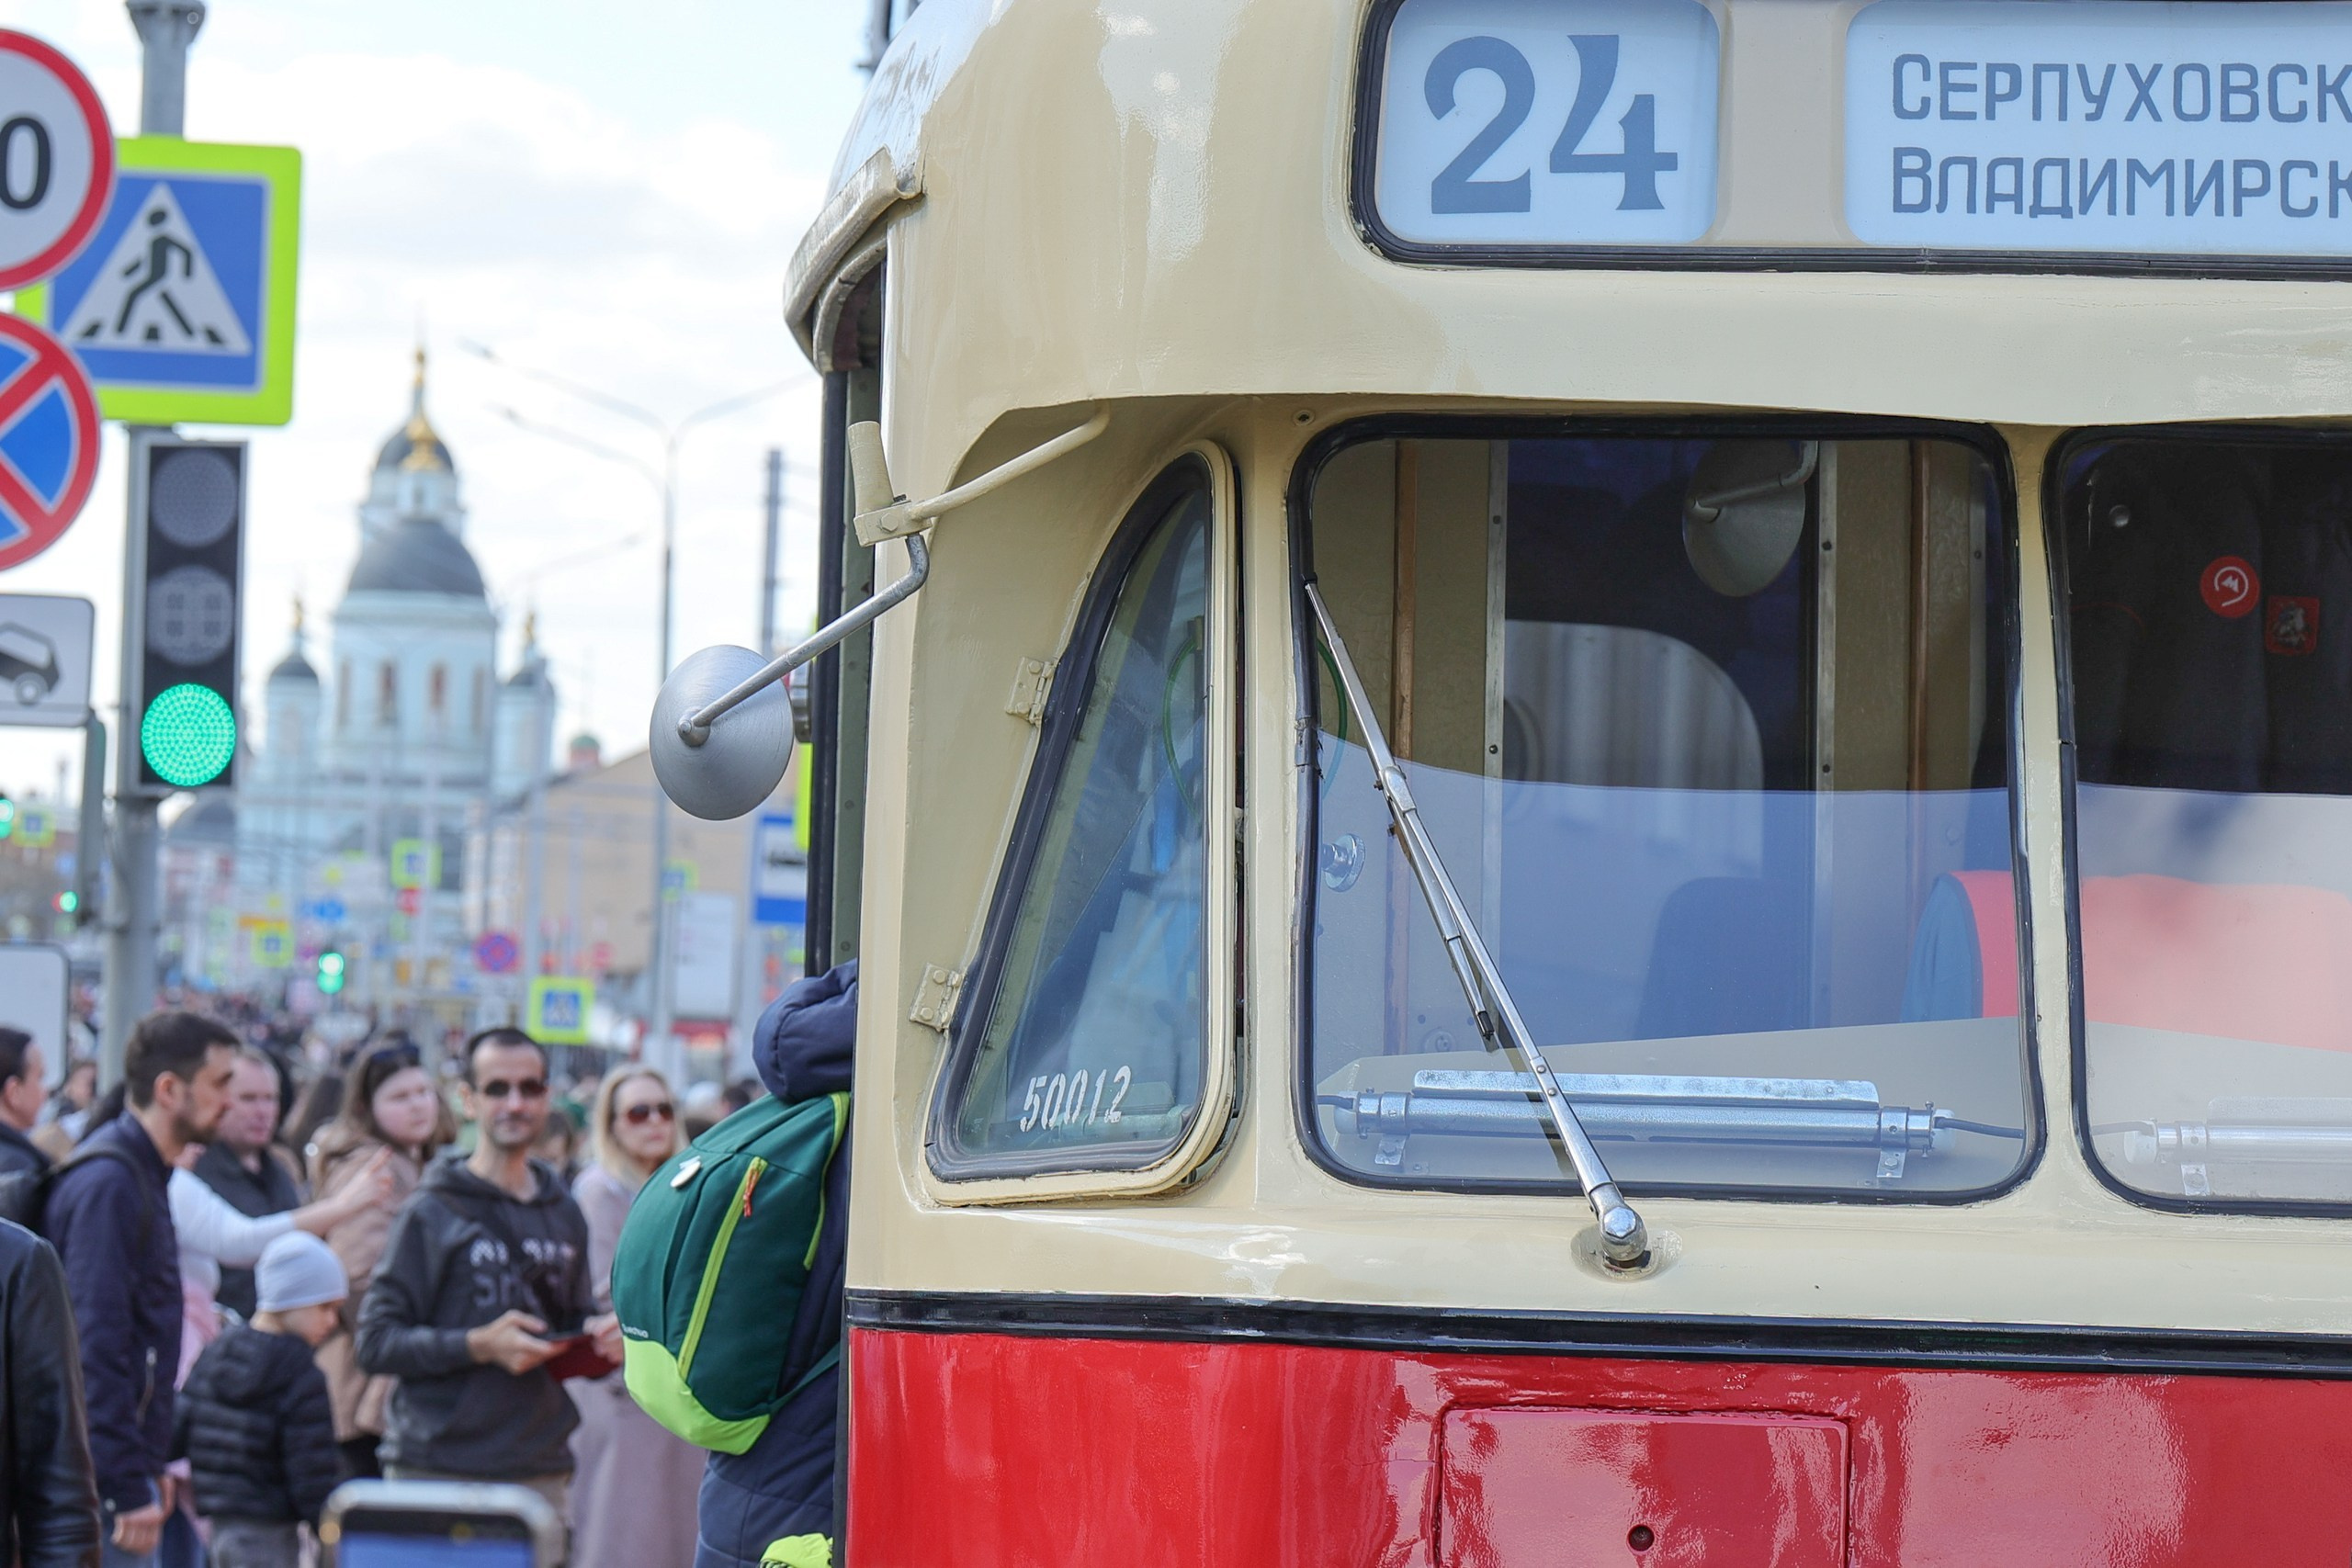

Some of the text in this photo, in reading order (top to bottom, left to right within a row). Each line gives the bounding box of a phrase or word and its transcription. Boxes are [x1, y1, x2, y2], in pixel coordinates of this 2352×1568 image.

[1893, 53, 2352, 124] СЕРПУХОВСК
[1424, 34, 1678, 215] 24
[1020, 1065, 1132, 1133] 50012
